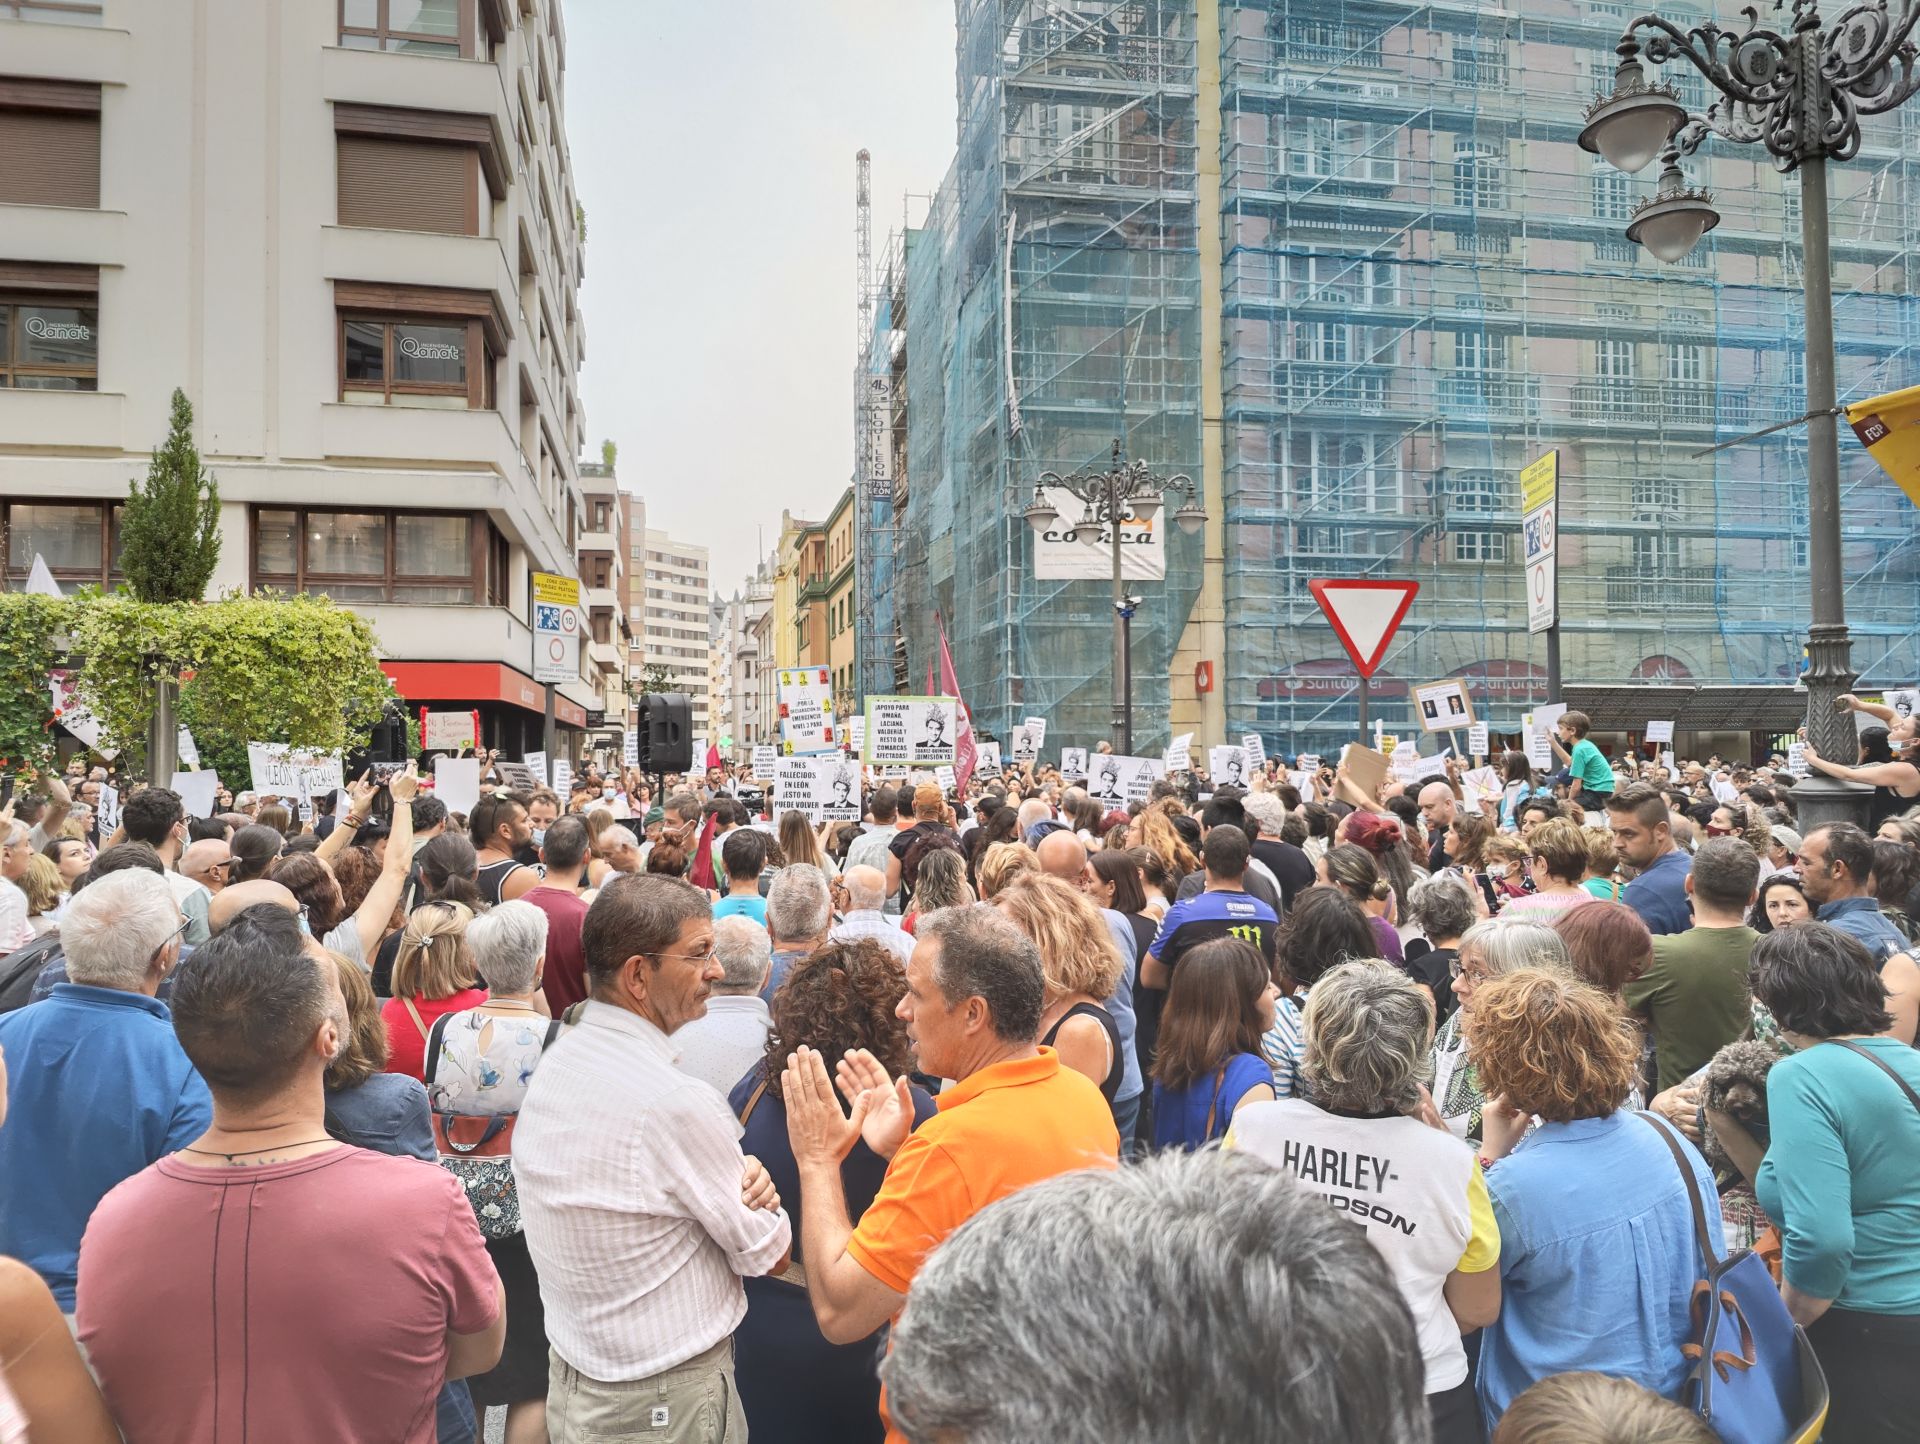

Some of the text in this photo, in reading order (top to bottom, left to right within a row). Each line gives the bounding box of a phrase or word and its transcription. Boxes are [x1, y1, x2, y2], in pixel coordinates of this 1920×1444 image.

[25, 316, 89, 340] Qanat
[400, 337, 459, 360] Qanat
[1864, 424, 1884, 441] FCP
[1544, 521, 1551, 537] 10
[565, 617, 573, 625] 10
[792, 714, 822, 722] EMERGENCIA
[782, 791, 800, 799] ¡ESTO
[774, 801, 819, 809] PUEDE VOLVER
[1283, 1140, 1399, 1193] HARLEY-
